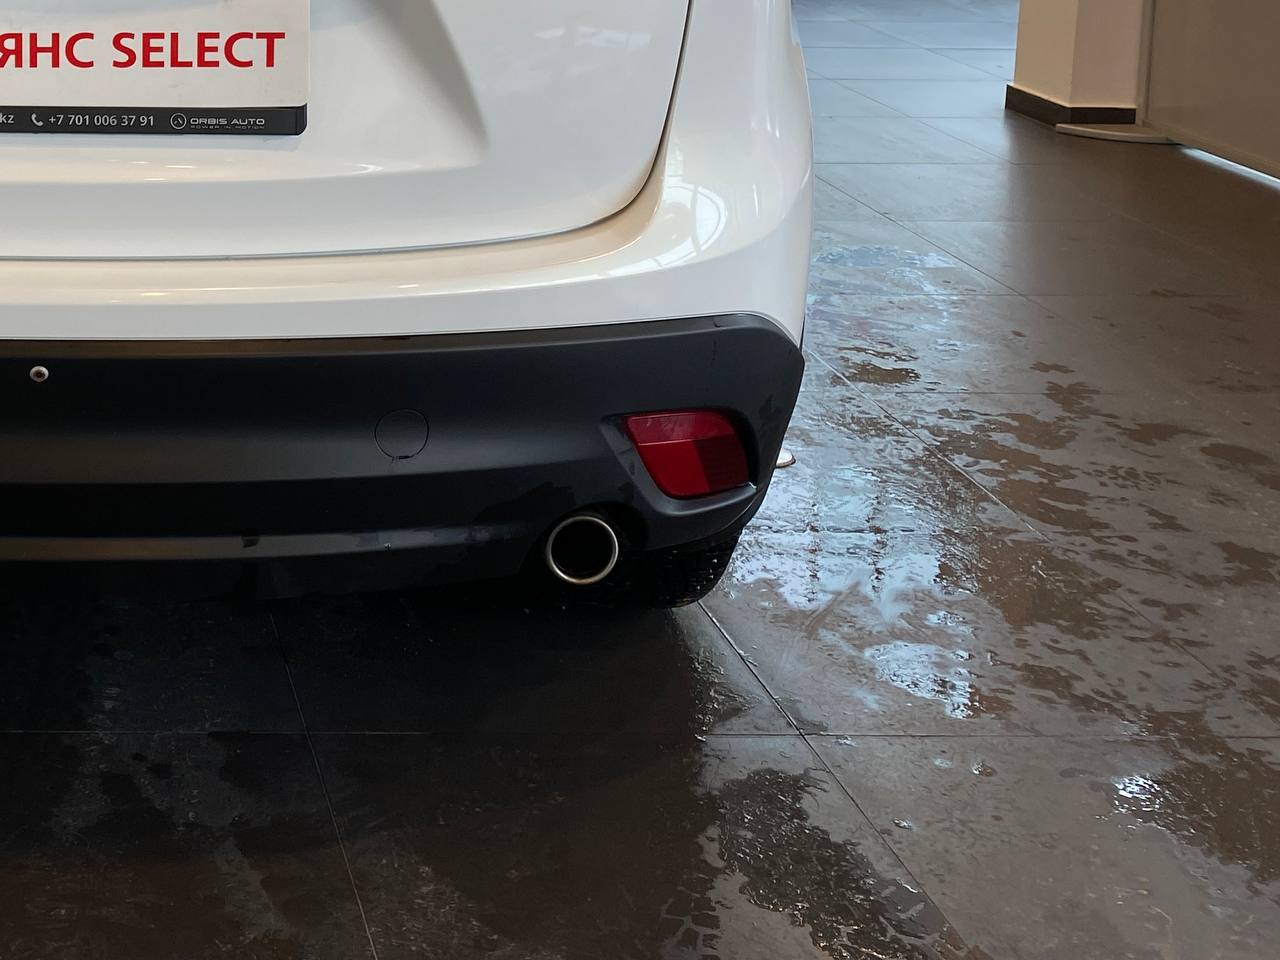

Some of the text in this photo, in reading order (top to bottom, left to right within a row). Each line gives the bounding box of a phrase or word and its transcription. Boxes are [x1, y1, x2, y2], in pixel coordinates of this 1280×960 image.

[112, 32, 286, 68] SELECT
[48, 114, 154, 127] +7 701 006 37 91
